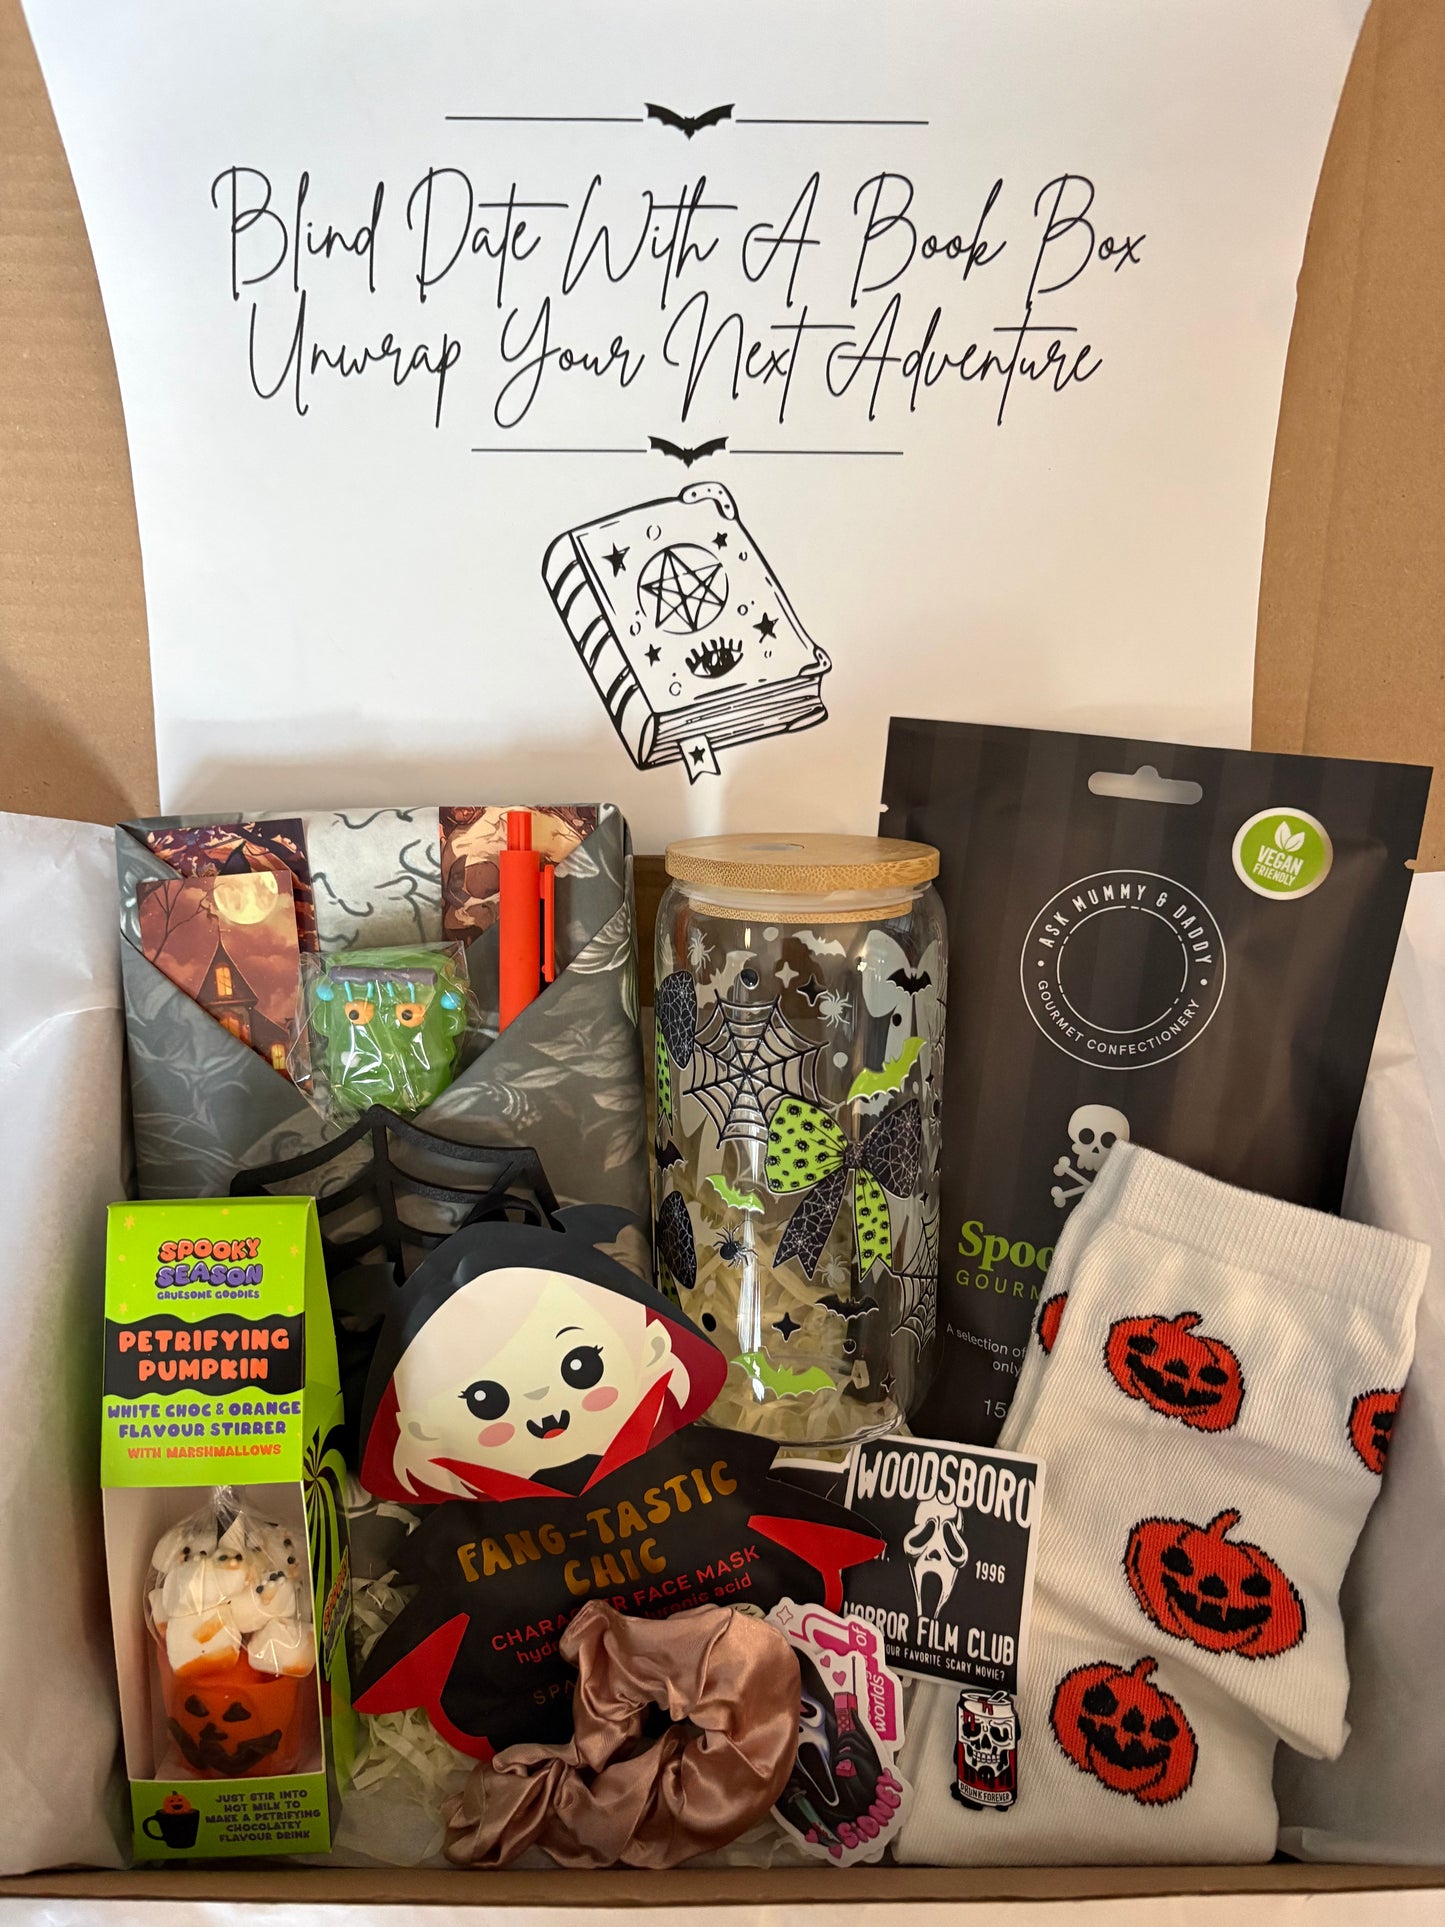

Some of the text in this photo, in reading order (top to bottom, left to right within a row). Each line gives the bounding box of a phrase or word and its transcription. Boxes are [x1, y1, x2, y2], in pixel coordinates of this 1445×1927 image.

[211, 166, 1146, 311] Blind Date With A Book Box
[249, 290, 1103, 428] Unwrap Your Next Adventure
[1257, 845, 1304, 876] VEGAN
[1252, 862, 1296, 886] FRIENDLY
[1038, 883, 1213, 965] ASK MUMMY & DADDY
[1037, 980, 1200, 1056] GOURMET CONFECTIONERY
[158, 1237, 262, 1264] SPOOKY
[958, 1220, 1055, 1272] Spoo
[155, 1261, 264, 1289] SEASON
[156, 1289, 260, 1300] GRUESOME GOODIES
[118, 1328, 290, 1353] PETRIFYING
[946, 1323, 1026, 1358] A selection of
[138, 1358, 269, 1382] PUMPKIN
[992, 1361, 1022, 1378] only
[108, 1401, 301, 1418] WHITE CHOC & ORANGE
[984, 1399, 1007, 1418] 15
[119, 1421, 286, 1438] FLAVOUR STIRRER
[128, 1443, 282, 1459] WITH MARSHMALLOWS
[857, 1450, 1035, 1529] WOODSBORO
[456, 1460, 738, 1583] FANG-TASTIC
[563, 1538, 667, 1596] CHIC
[975, 1560, 1006, 1584] 1996
[713, 1572, 752, 1598] acid
[491, 1545, 761, 1652] CHARAR FACE MASK
[852, 1625, 867, 1647] of
[916, 1616, 959, 1655] FILM
[967, 1628, 1015, 1666] CLUB
[886, 1644, 1005, 1682] OUR FAVORITE SCARY MOVIE?
[869, 1674, 887, 1733] worlds
[216, 1789, 308, 1803] JUST STIR INTO
[960, 1783, 1010, 1802] DRUNK FOREVER
[205, 1809, 321, 1824] MAKE A PETRIFYING
[224, 1800, 301, 1813] HOT MILK TO
[219, 1829, 310, 1842] FLAVOUR DRINK
[226, 1821, 302, 1832] CHOCOLATEY
